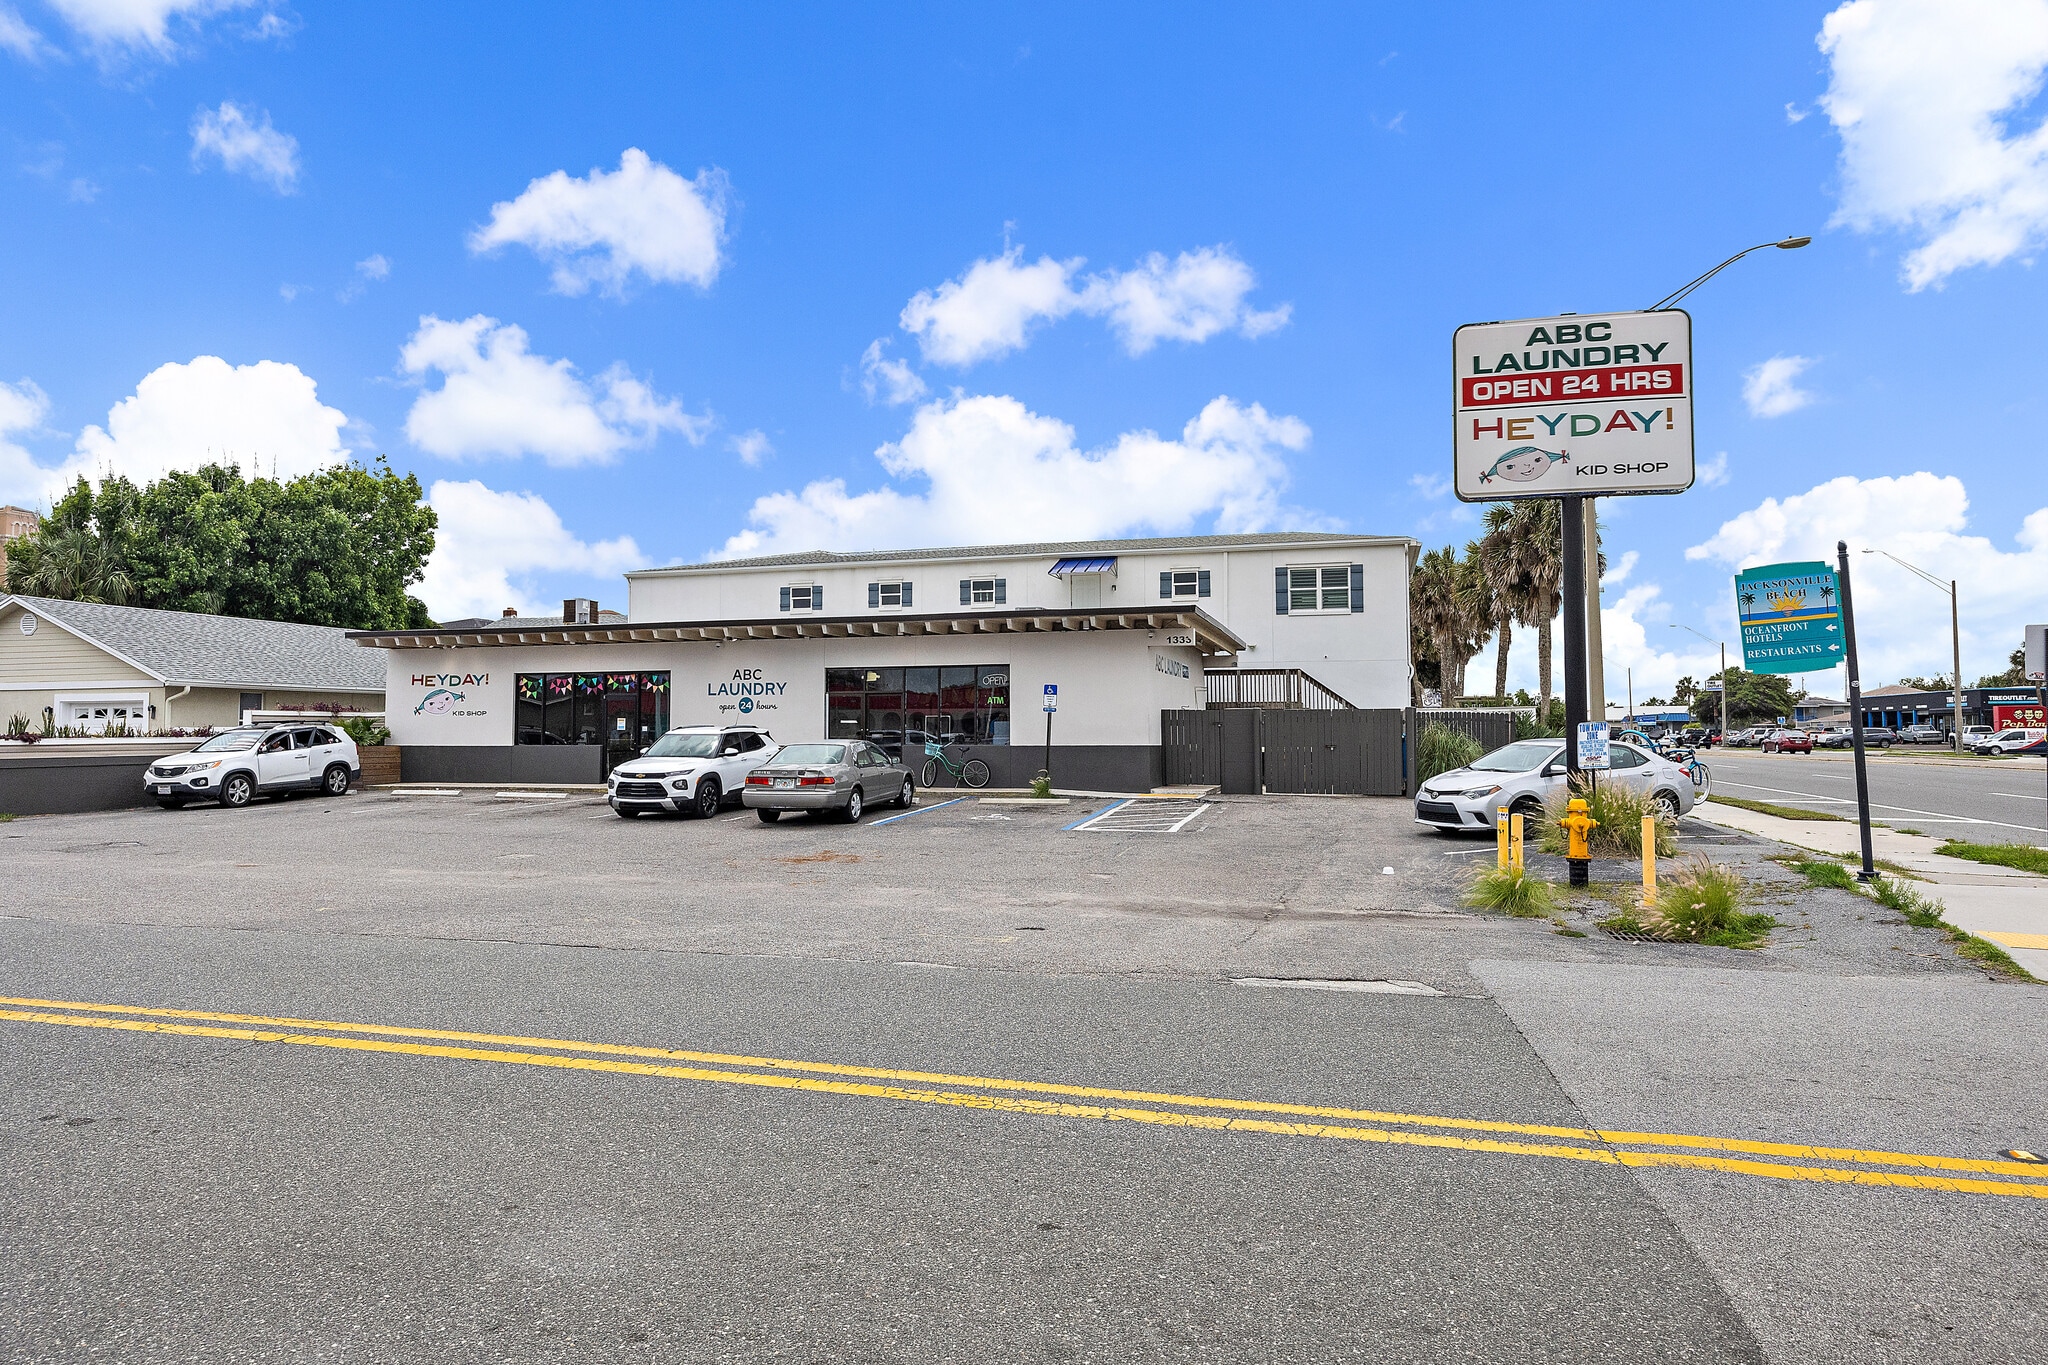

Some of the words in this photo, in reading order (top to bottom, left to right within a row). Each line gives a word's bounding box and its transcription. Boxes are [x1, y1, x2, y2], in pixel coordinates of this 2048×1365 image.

[1525, 321, 1612, 347] ABC
[1473, 342, 1669, 375] LAUNDRY
[1473, 377, 1552, 401] OPEN
[1562, 374, 1600, 395] 24
[1611, 370, 1673, 392] HRS
[1473, 407, 1674, 441] HEYDAY!
[1576, 464, 1608, 476] KID
[1613, 462, 1669, 474] SHOP
[1740, 574, 1832, 592] JACKSONVILLE
[1766, 588, 1807, 600] BEACH
[1744, 621, 1809, 636] OCEANFRONT
[1745, 632, 1783, 644] HOTELS
[1747, 644, 1822, 659] RESTAURANTS
[411, 673, 489, 687] HEYDAY!
[732, 669, 762, 681] ABC
[708, 682, 787, 696] LAUNDRY
[719, 703, 737, 714] open
[740, 701, 752, 710] 24
[756, 700, 778, 710] hours
[987, 696, 1004, 705] ATM
[1580, 724, 1590, 733] TOW
[1591, 722, 1607, 731] AWAY
[2001, 719, 2025, 729] Pep
[1587, 732, 1598, 740] ZONE
